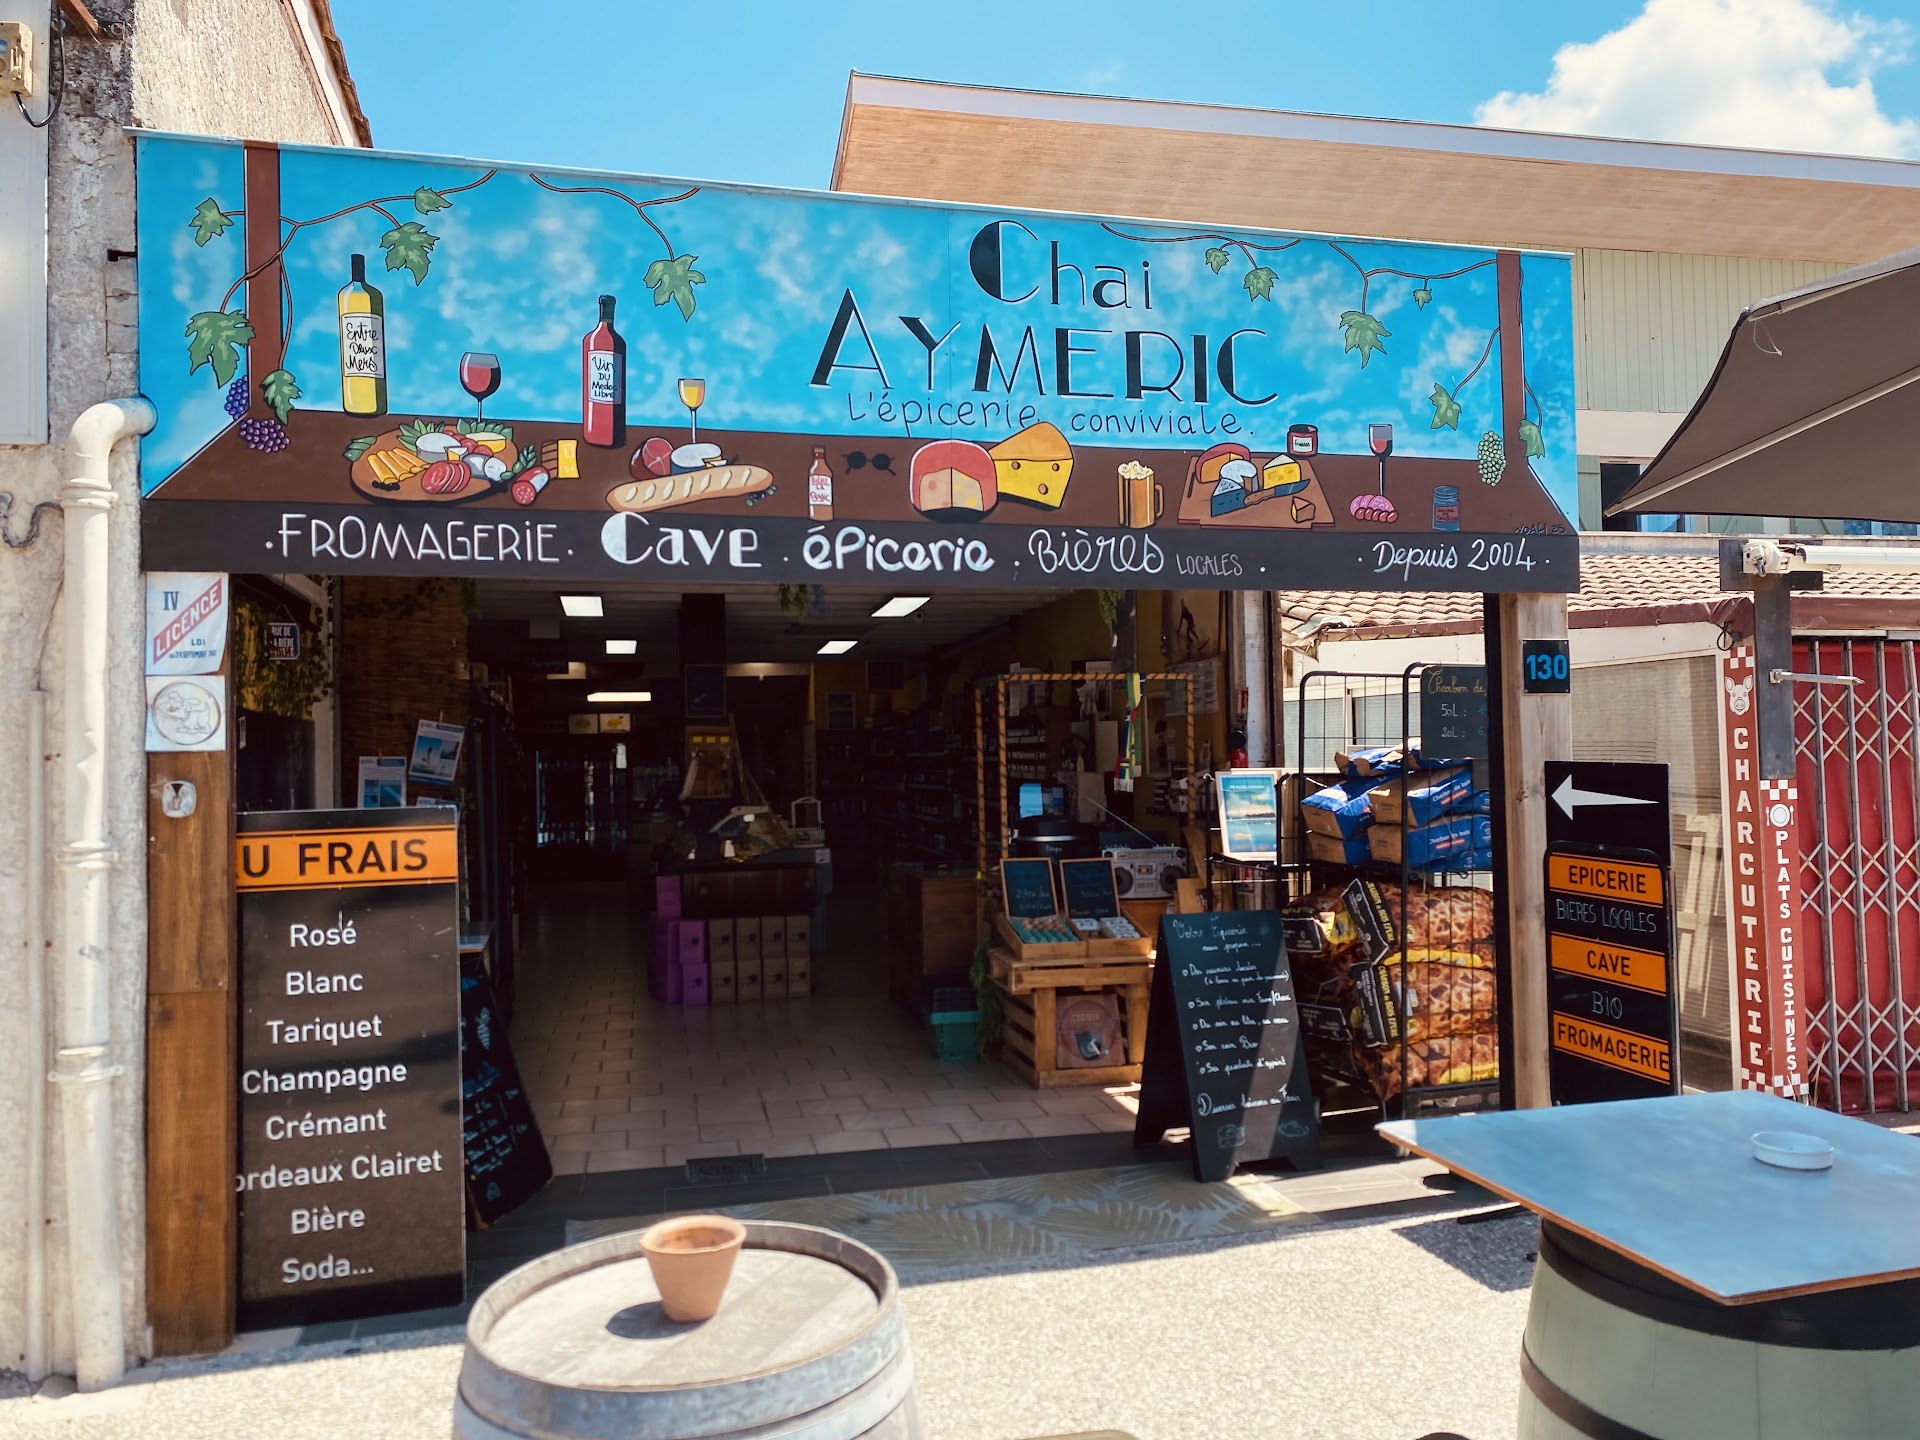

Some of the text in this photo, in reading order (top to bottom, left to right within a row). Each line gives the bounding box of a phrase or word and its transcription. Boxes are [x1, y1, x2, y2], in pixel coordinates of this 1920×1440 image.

[969, 219, 1153, 311] Chai
[346, 321, 379, 342] Entre
[808, 287, 1278, 405] AYMERIC
[591, 356, 616, 372] Vin
[598, 372, 611, 381] DU
[1028, 528, 1165, 574] Bières
[1175, 552, 1243, 577] LOCALES
[1372, 539, 1459, 582] Depuis
[1467, 537, 1537, 572] 2004
[163, 590, 180, 611] IV
[156, 585, 219, 657] LICENCE
[191, 638, 206, 646] LOI
[1428, 665, 1469, 695] Charbon
[1526, 654, 1568, 681] 130
[299, 838, 429, 876] FRAIS
[1569, 865, 1647, 894] EPICERIE
[1774, 830, 1791, 919] PLATS
[1733, 727, 1766, 1067] CHARCUTERIE
[1556, 898, 1657, 933] BIERES LOCALES
[289, 920, 358, 949] Rosé
[1586, 949, 1631, 977] CAVE
[285, 972, 364, 996] Blanc
[266, 1015, 384, 1046] Tariquet
[1558, 1022, 1670, 1073] FROMAGERIE
[242, 1061, 408, 1095] Champagne
[266, 1108, 387, 1141] Crémant
[351, 1149, 443, 1180] Clairet
[291, 1207, 366, 1235] Bière
[281, 1253, 375, 1285] Soda...
